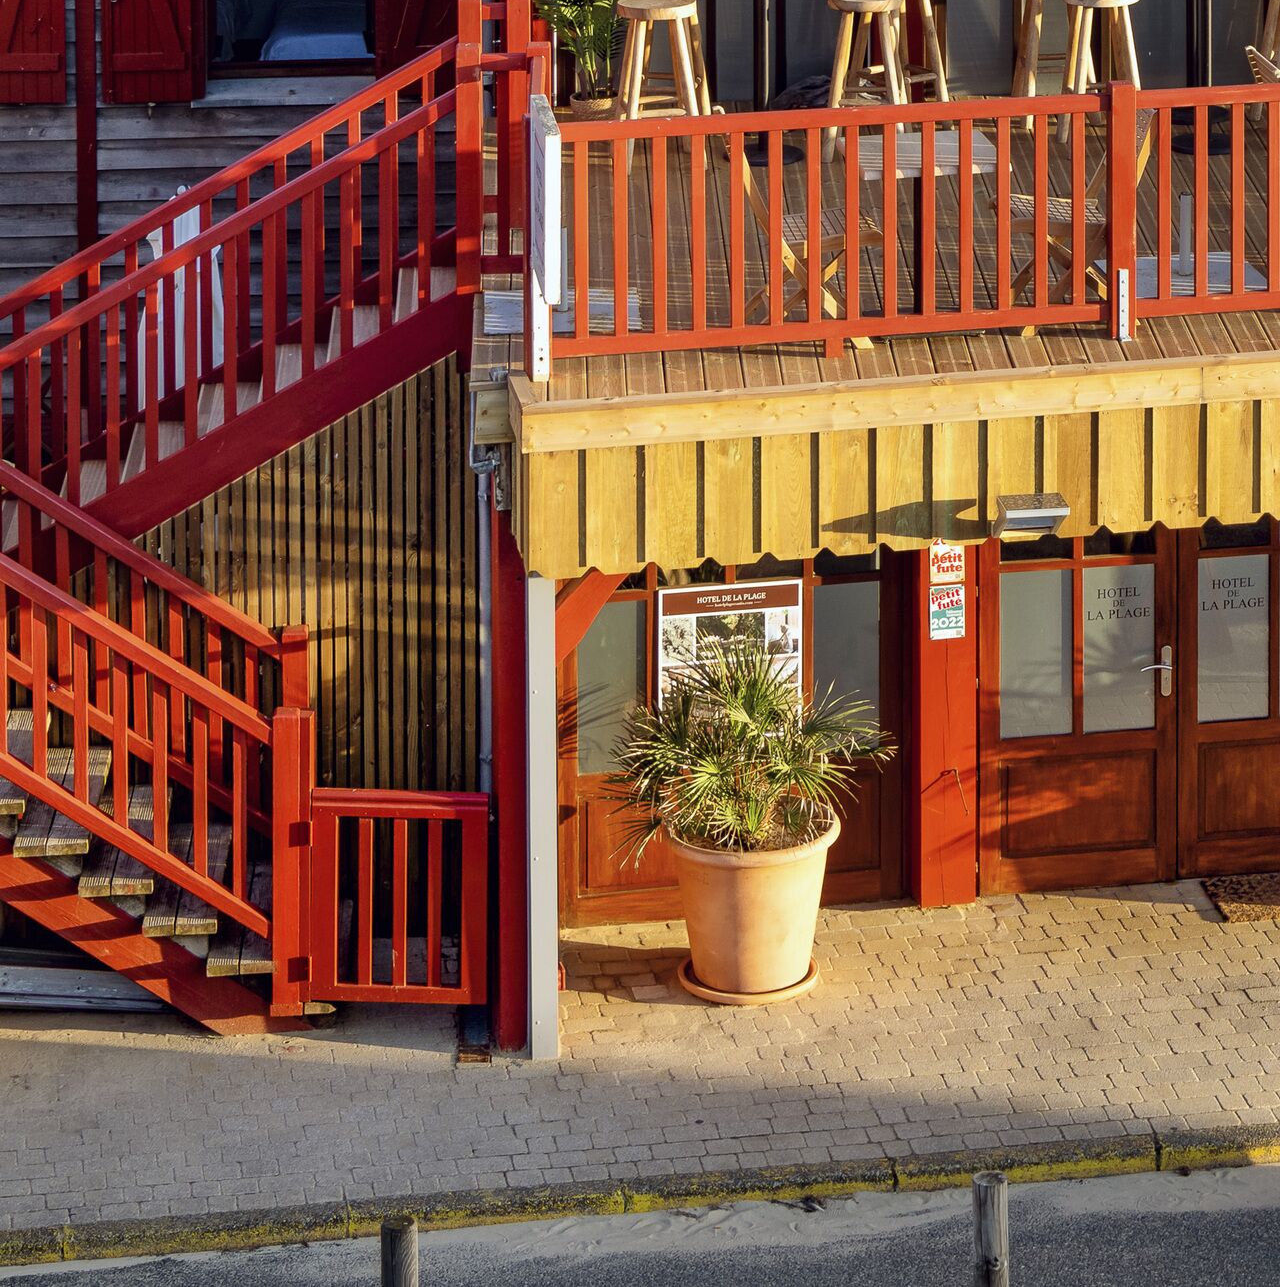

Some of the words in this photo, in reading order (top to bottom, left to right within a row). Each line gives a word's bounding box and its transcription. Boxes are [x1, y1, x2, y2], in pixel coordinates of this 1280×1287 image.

[931, 553, 963, 567] petit
[1211, 577, 1255, 590] HOTEL
[697, 596, 721, 604] HOTEL
[743, 592, 766, 600] PLAGE
[931, 588, 961, 605] petit
[1097, 586, 1141, 599] HOTEL
[1227, 589, 1240, 598] DE
[1112, 599, 1126, 608] DE
[1202, 600, 1219, 611] LA
[1223, 596, 1265, 610] PLAGE
[1087, 610, 1104, 621] LA
[1108, 606, 1151, 620] PLAGE
[932, 617, 963, 628] 2022
